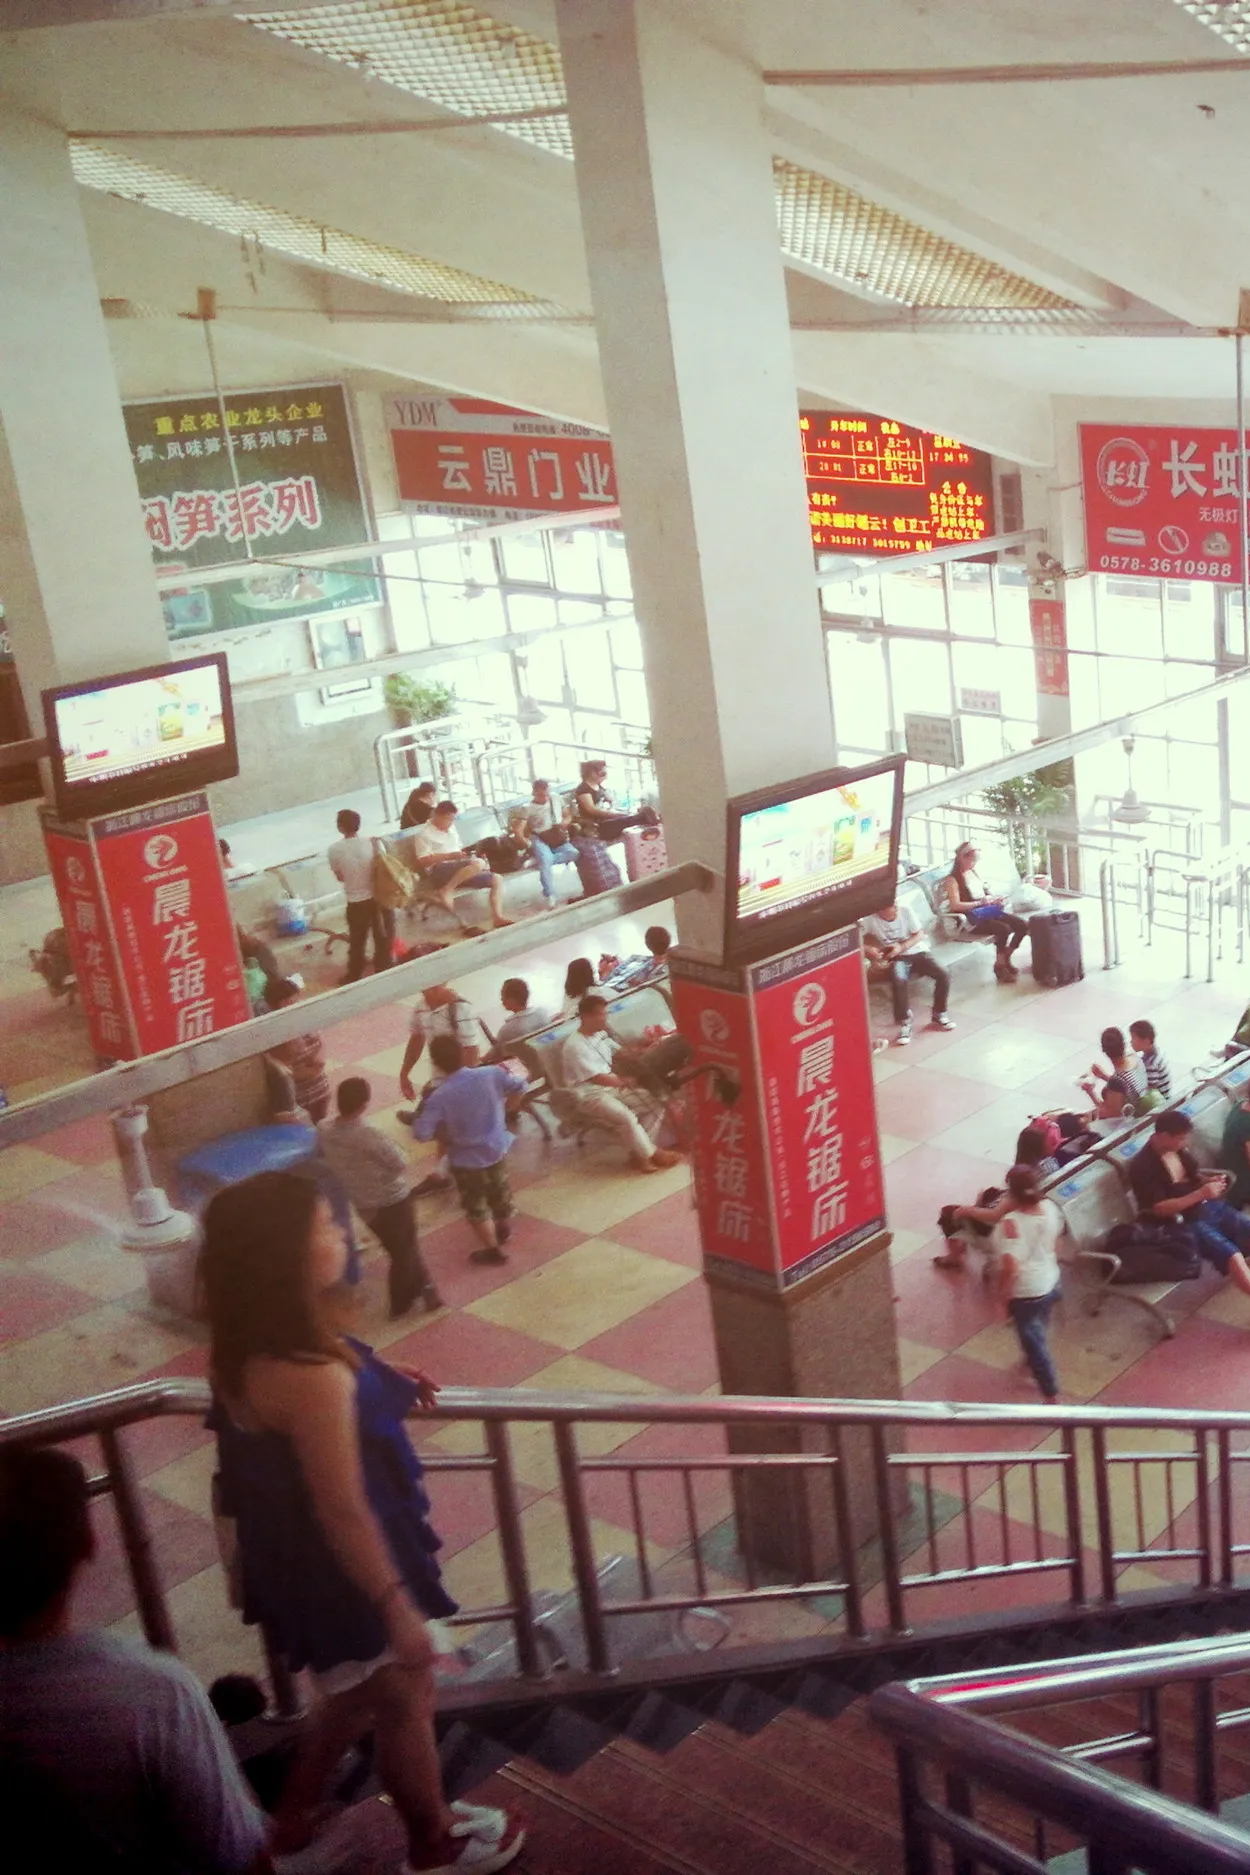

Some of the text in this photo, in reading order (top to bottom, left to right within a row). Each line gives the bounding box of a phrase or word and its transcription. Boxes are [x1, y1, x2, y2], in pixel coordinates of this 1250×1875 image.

[394, 401, 437, 426] YDM
[437, 445, 615, 502] 云鼎门业
[1199, 507, 1239, 524] 无极灯
[1100, 555, 1232, 577] 0578-3610988
[153, 878, 215, 1044] 晨龙锯床
[796, 1034, 850, 1242] 晨龙锯床
